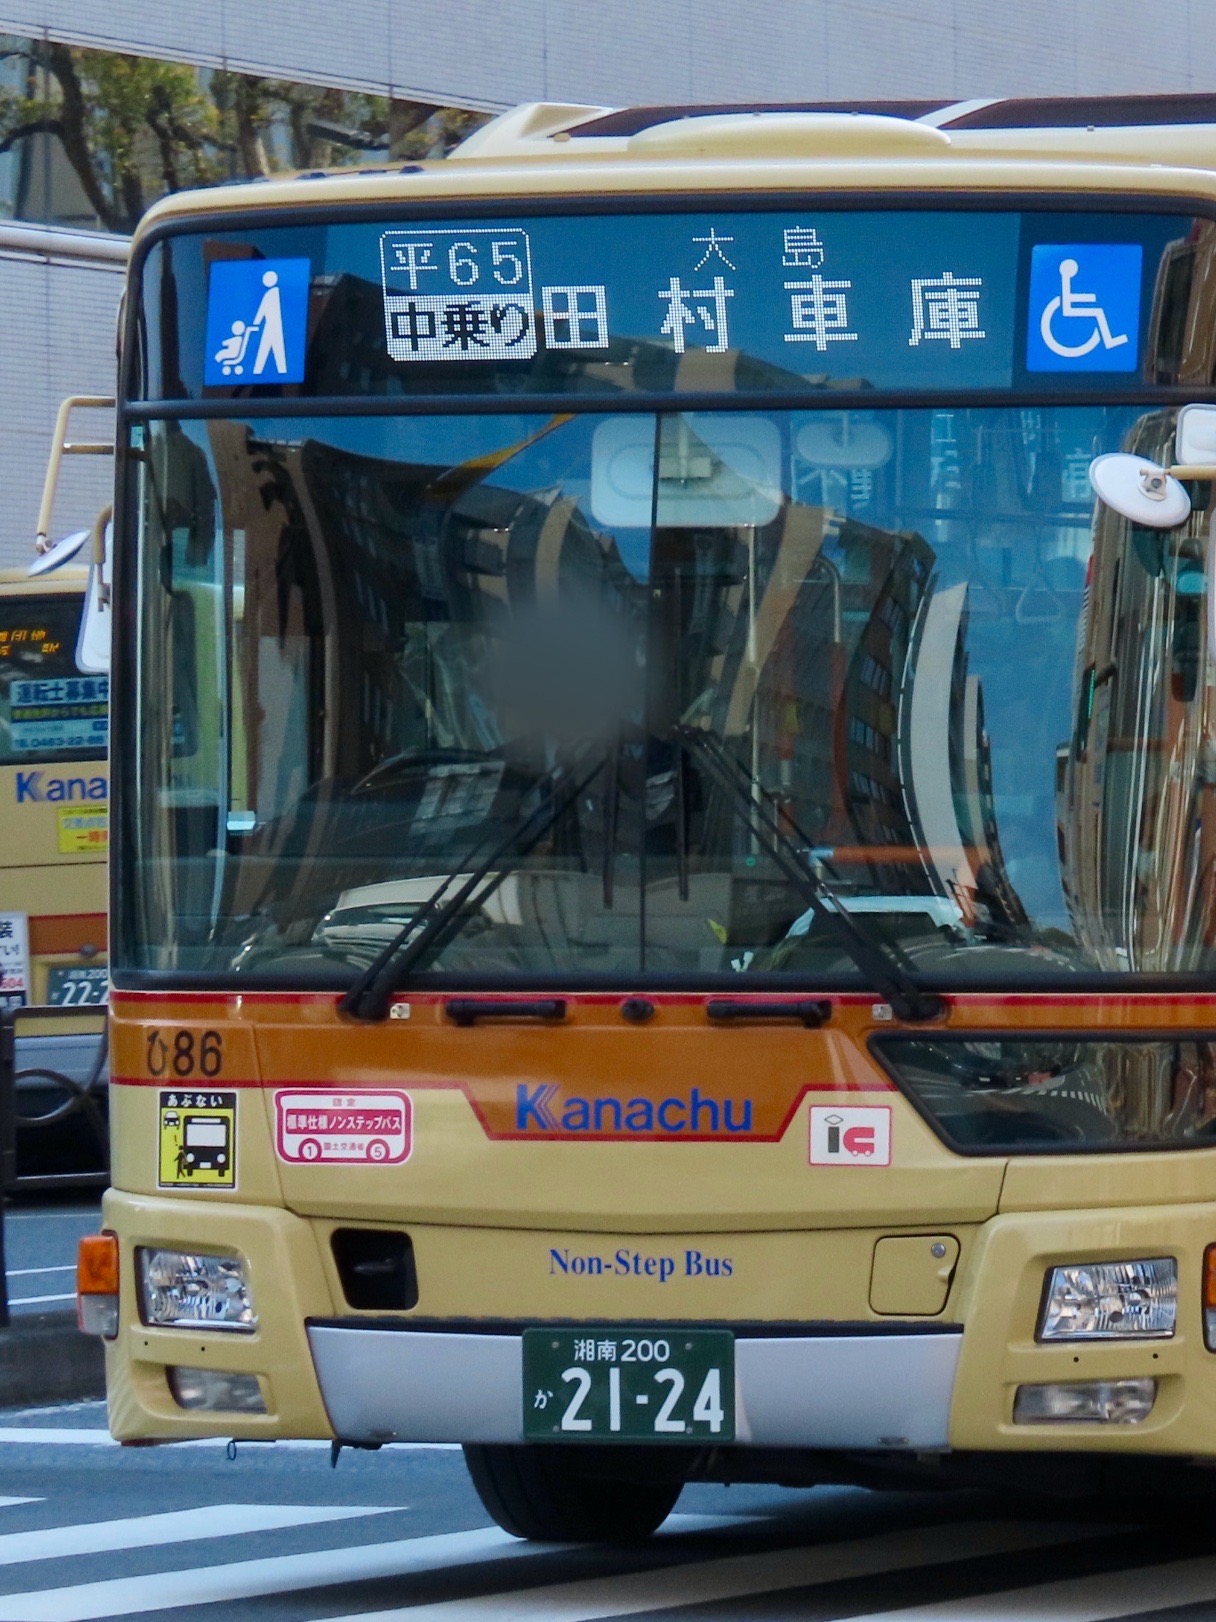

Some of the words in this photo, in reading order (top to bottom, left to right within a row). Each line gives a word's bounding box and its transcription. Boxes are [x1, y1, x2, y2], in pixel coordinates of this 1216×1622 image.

[391, 241, 526, 289] 平65
[692, 226, 826, 272] 大島
[391, 300, 531, 351] 中乗り
[543, 272, 986, 354] 田村車庫
[167, 1093, 223, 1108] あぶない
[516, 1082, 752, 1132] Kanachu
[549, 1248, 675, 1283] Non-Step
[684, 1250, 734, 1277] Bus
[573, 1338, 671, 1363] 湘南200
[533, 1389, 554, 1410] か
[560, 1366, 725, 1434] 21-24
